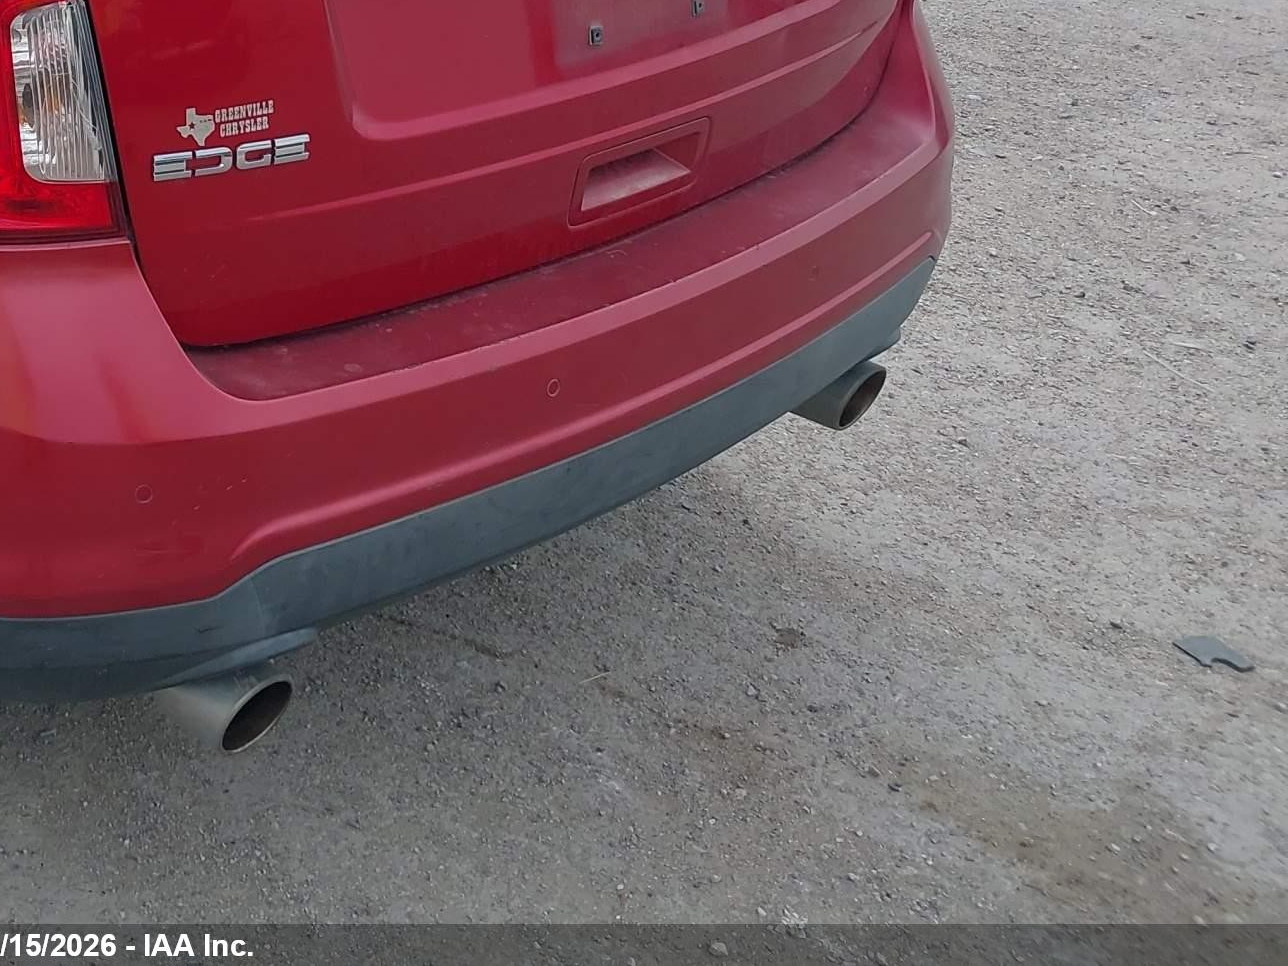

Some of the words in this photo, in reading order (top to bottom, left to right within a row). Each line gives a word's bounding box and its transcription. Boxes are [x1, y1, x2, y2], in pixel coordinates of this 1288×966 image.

[214, 99, 274, 124] GREENVILLE
[219, 116, 270, 138] CHRYSLER
[153, 133, 311, 182] EDGE
